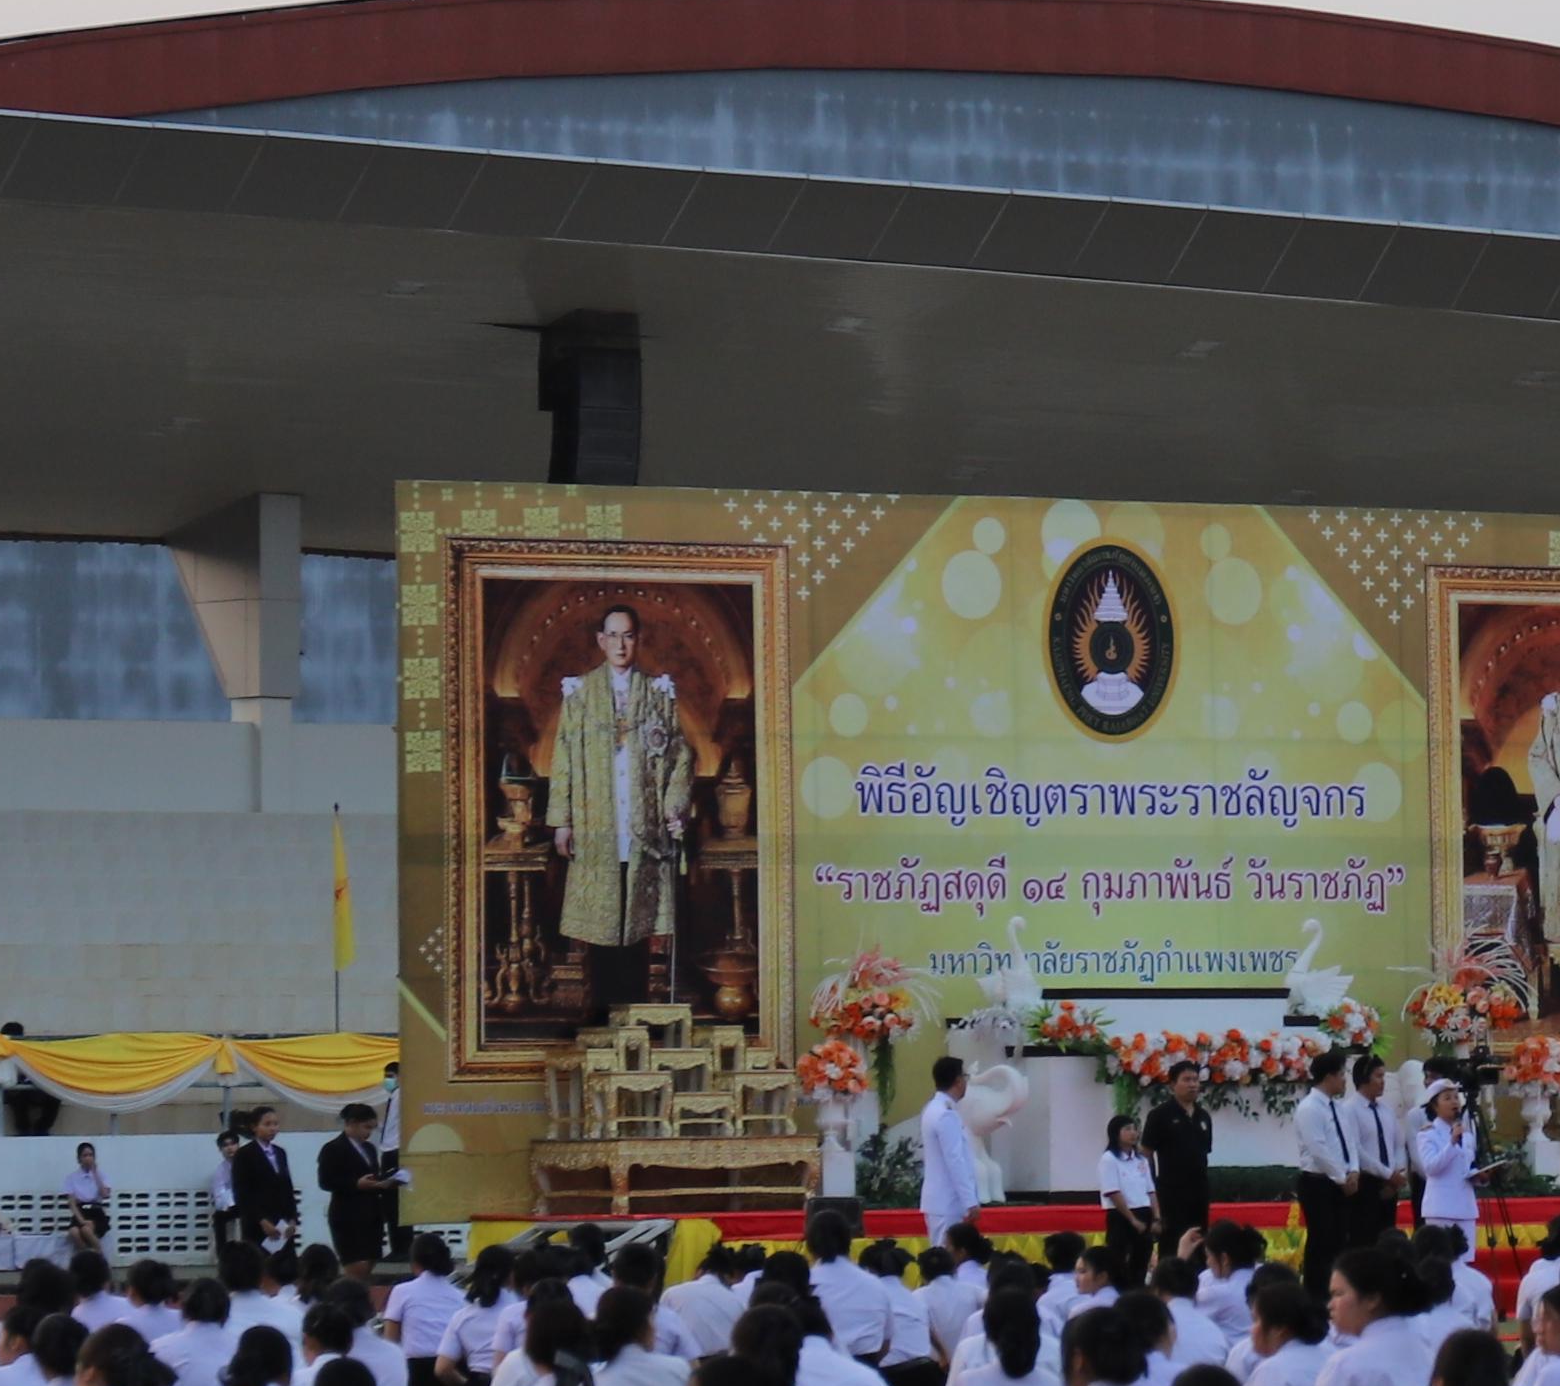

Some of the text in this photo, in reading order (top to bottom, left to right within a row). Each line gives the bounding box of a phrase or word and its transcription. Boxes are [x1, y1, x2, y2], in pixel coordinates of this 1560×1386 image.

[855, 763, 1366, 828] พิธีอัญเชิญตราพระราชลัญจกร
[1022, 872, 1068, 904] ๑๔
[1082, 856, 1235, 917] กุมภาพันธ์
[928, 939, 1298, 983] มหาวิทาลัยราชภัฏกำแพงเพชร
